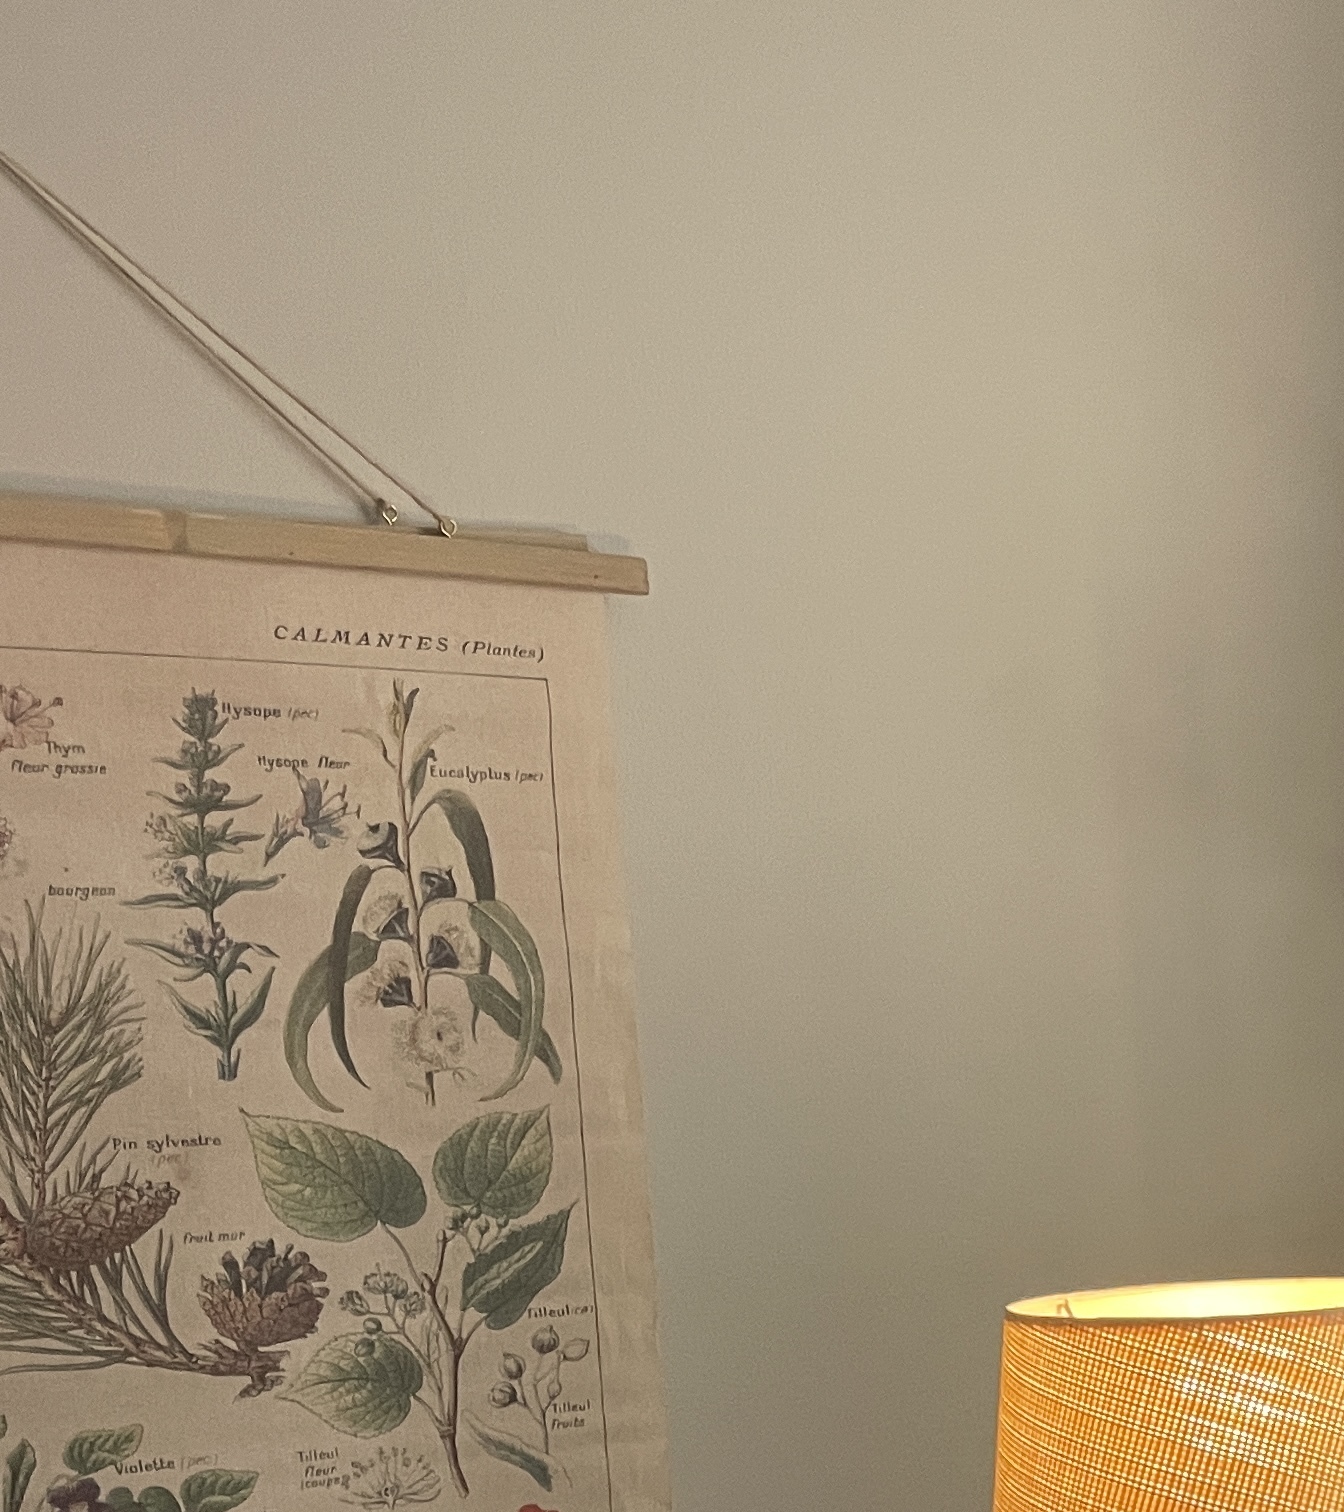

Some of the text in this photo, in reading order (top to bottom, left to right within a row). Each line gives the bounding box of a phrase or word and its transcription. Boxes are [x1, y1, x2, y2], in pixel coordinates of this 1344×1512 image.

[273, 625, 545, 663] CALMANTES (Plantes)
[46, 740, 86, 758] Thym
[429, 764, 511, 783] Eucalyptus
[112, 1133, 222, 1153] Pin sylvestre
[114, 1458, 176, 1475] Violette
